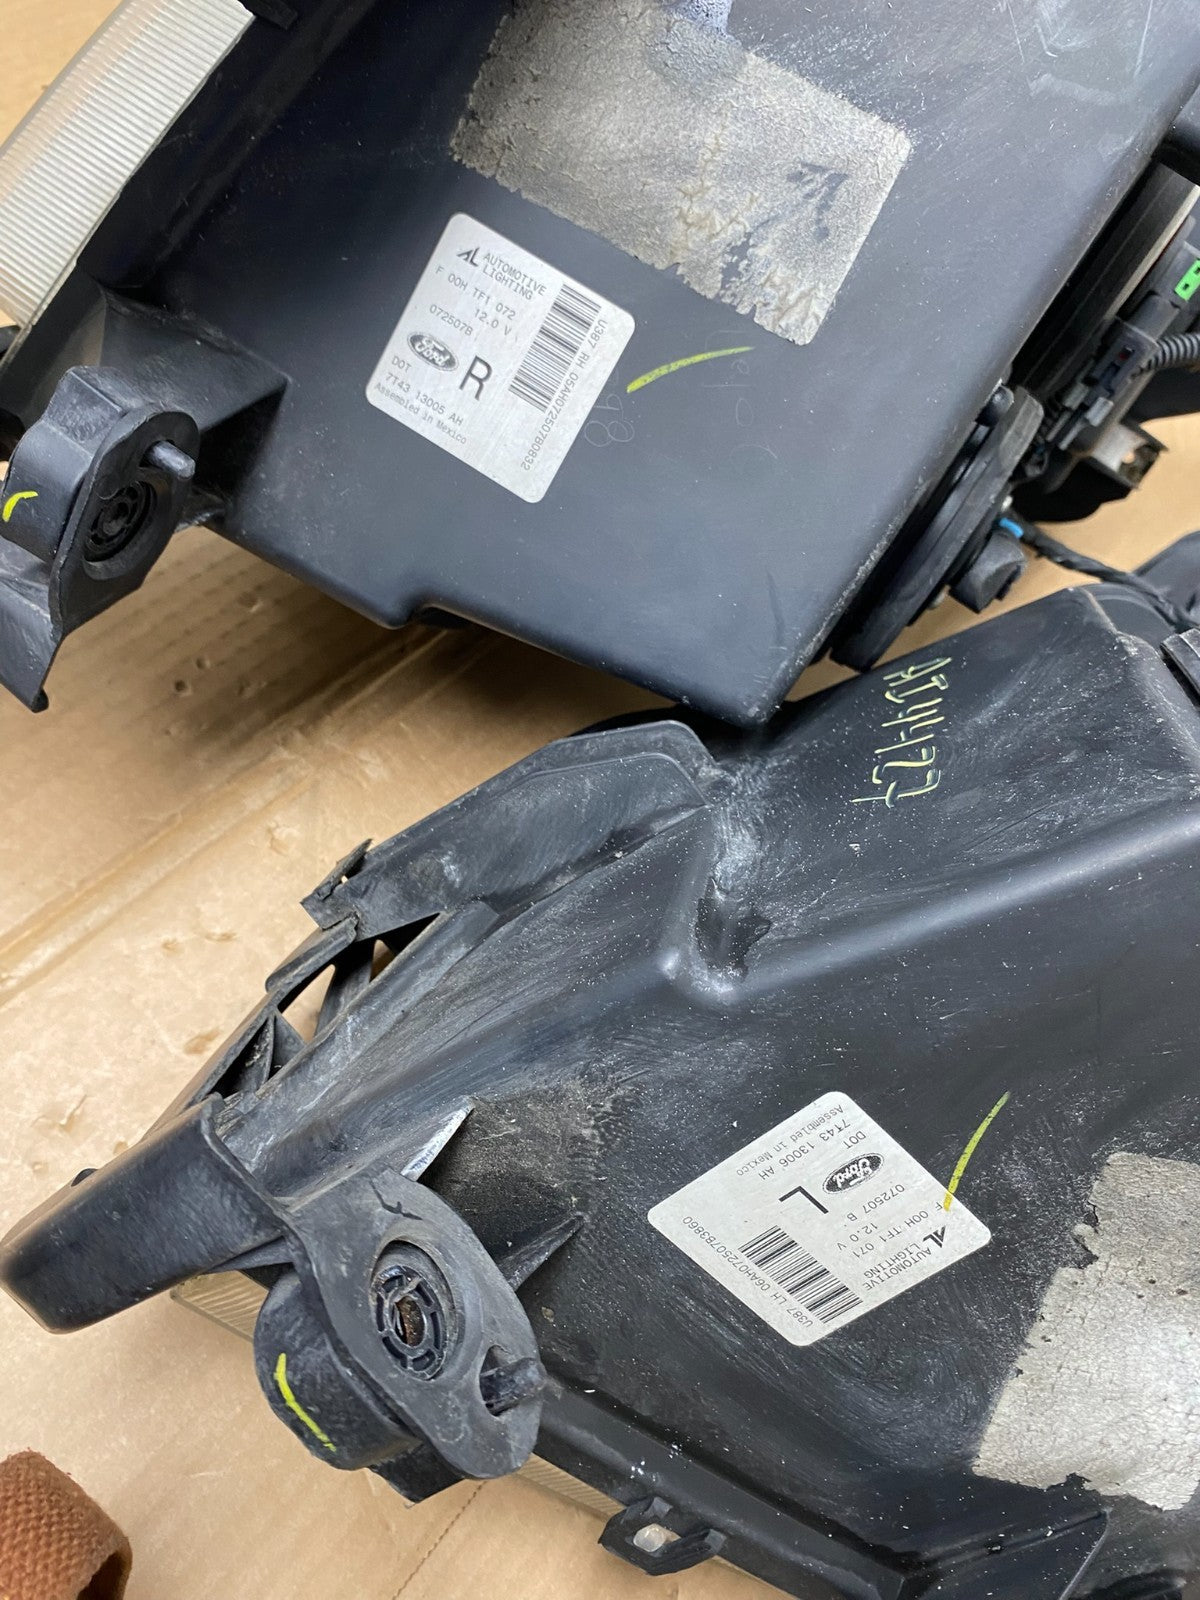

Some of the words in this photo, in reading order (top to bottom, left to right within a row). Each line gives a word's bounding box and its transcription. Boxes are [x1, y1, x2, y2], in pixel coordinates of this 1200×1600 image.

[482, 264, 533, 300] LIGHTING
[483, 252, 547, 297] AUTOMOTIVE
[435, 265, 445, 275] F
[472, 288, 491, 305] TF1
[495, 302, 516, 320] 072
[473, 308, 499, 330] 12.0
[504, 324, 513, 336] V
[588, 319, 608, 350] U387
[391, 355, 412, 374] DOT
[575, 352, 590, 369] RH
[458, 355, 493, 401] R
[386, 372, 411, 394] 7T43
[414, 390, 446, 415] 13005
[449, 410, 464, 427] AH
[373, 382, 420, 415] Assembled
[421, 410, 433, 425] in
[436, 418, 467, 445] Mexico
[790, 1104, 844, 1142] Assembled
[819, 1118, 851, 1142] 7T43
[772, 1141, 788, 1153] in
[842, 1130, 867, 1149] DOT
[736, 1151, 773, 1176] Mexico
[778, 1141, 815, 1168] 13006
[758, 1165, 775, 1180] AH
[778, 1185, 829, 1214] L
[862, 1184, 905, 1214] 072507
[934, 1201, 943, 1211] F
[849, 1222, 878, 1242] 12.0
[879, 1226, 902, 1243] TF1
[836, 1241, 847, 1251] V
[853, 1242, 875, 1258] 071
[863, 1242, 921, 1279] LIGHTING
[865, 1247, 932, 1291] AUTOMOTIVE
[770, 1291, 788, 1305] LH
[786, 1307, 814, 1328] U387
